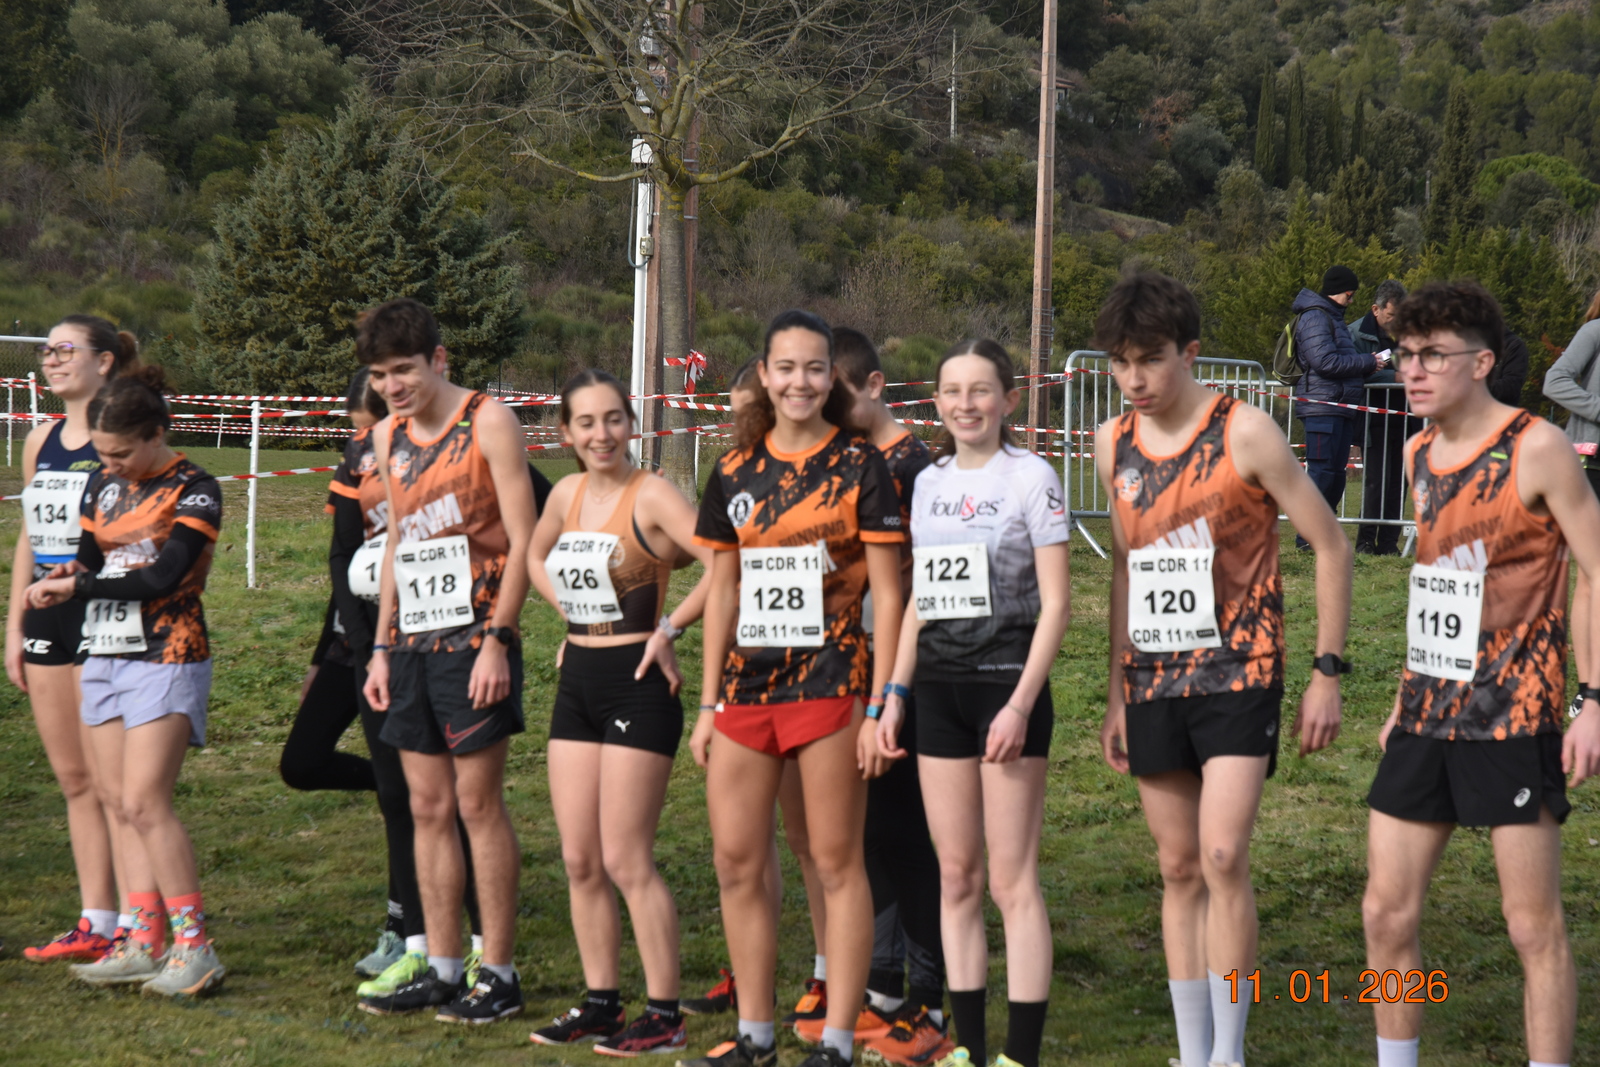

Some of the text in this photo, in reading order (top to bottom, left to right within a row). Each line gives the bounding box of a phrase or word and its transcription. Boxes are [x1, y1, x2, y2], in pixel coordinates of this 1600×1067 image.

[46, 479, 68, 491] CDR
[71, 480, 83, 491] 11
[33, 504, 68, 524] 134
[420, 546, 447, 562] CDR
[450, 544, 467, 558] 11
[572, 540, 595, 553] CDR
[598, 542, 613, 554] 11
[766, 557, 796, 570] CDR
[804, 557, 819, 570] 11
[924, 556, 970, 582] 122
[1158, 558, 1186, 572] CDR
[1194, 557, 1210, 571] 11
[409, 573, 456, 599] 118
[558, 567, 599, 590] 126
[1430, 577, 1456, 596] CDR
[1464, 581, 1481, 598] 11
[753, 586, 805, 611] 128
[917, 597, 937, 611] CDR
[941, 596, 956, 609] 11
[1144, 589, 1196, 614] 120
[94, 601, 128, 622] 115
[404, 611, 427, 625] CDR
[432, 609, 445, 622] 11
[577, 603, 590, 615] 11
[741, 624, 767, 638] CDR
[773, 624, 788, 638] 11
[1417, 608, 1462, 639] 119
[100, 634, 114, 646] 11
[1132, 630, 1161, 643] CDR
[1167, 629, 1183, 642] 11
[23, 639, 53, 654] KE
[1410, 646, 1428, 664] CDR
[1430, 652, 1443, 669] 11
